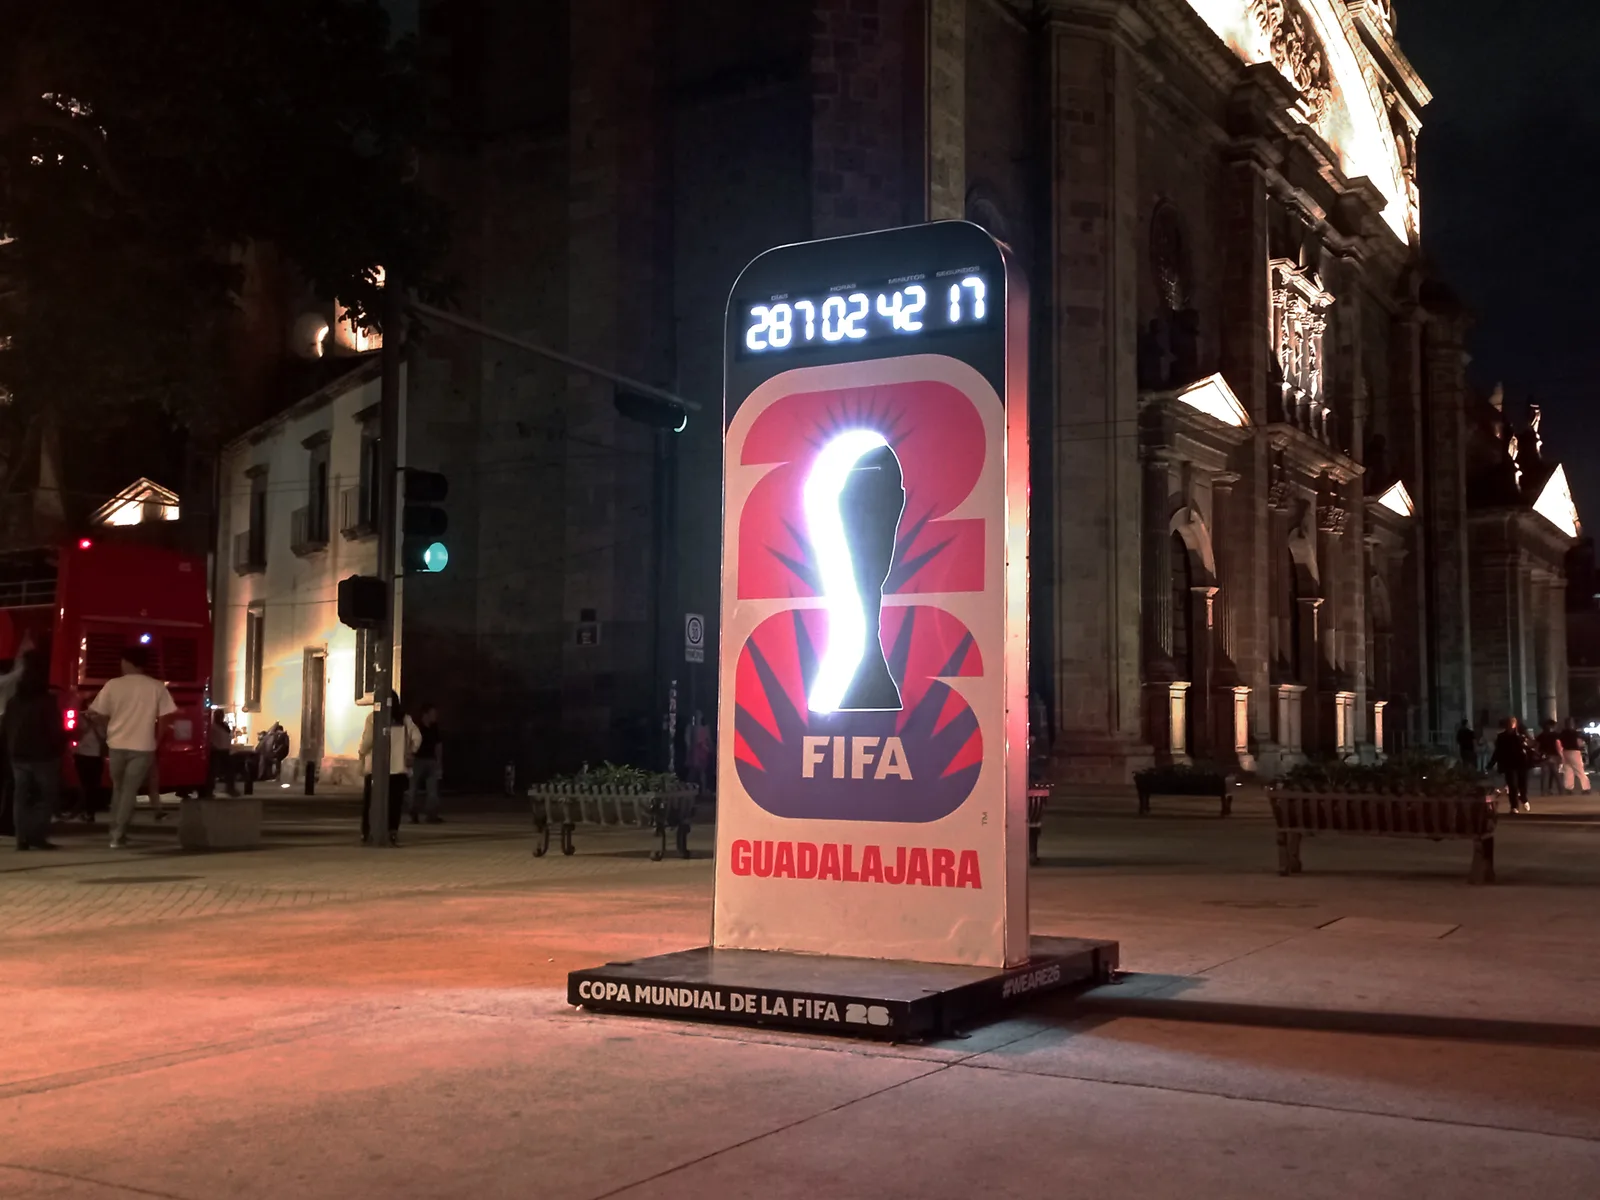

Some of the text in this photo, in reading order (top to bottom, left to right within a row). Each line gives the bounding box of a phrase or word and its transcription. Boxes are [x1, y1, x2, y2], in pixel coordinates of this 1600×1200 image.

[830, 283, 857, 292] HORAS
[888, 273, 926, 285] MINUTOS
[935, 265, 980, 277] SEGUNDOS
[822, 293, 869, 341] 02
[877, 285, 926, 331] 42
[949, 277, 985, 322] 17
[802, 735, 913, 780] FIFA
[731, 839, 982, 889] GUADALAJARA
[1002, 965, 1060, 998] #WEARE26
[579, 980, 631, 1003] COPA
[635, 985, 726, 1011] MUNDIAL
[730, 992, 757, 1014] DE
[761, 995, 788, 1017] LA
[793, 998, 840, 1022] FIFA
